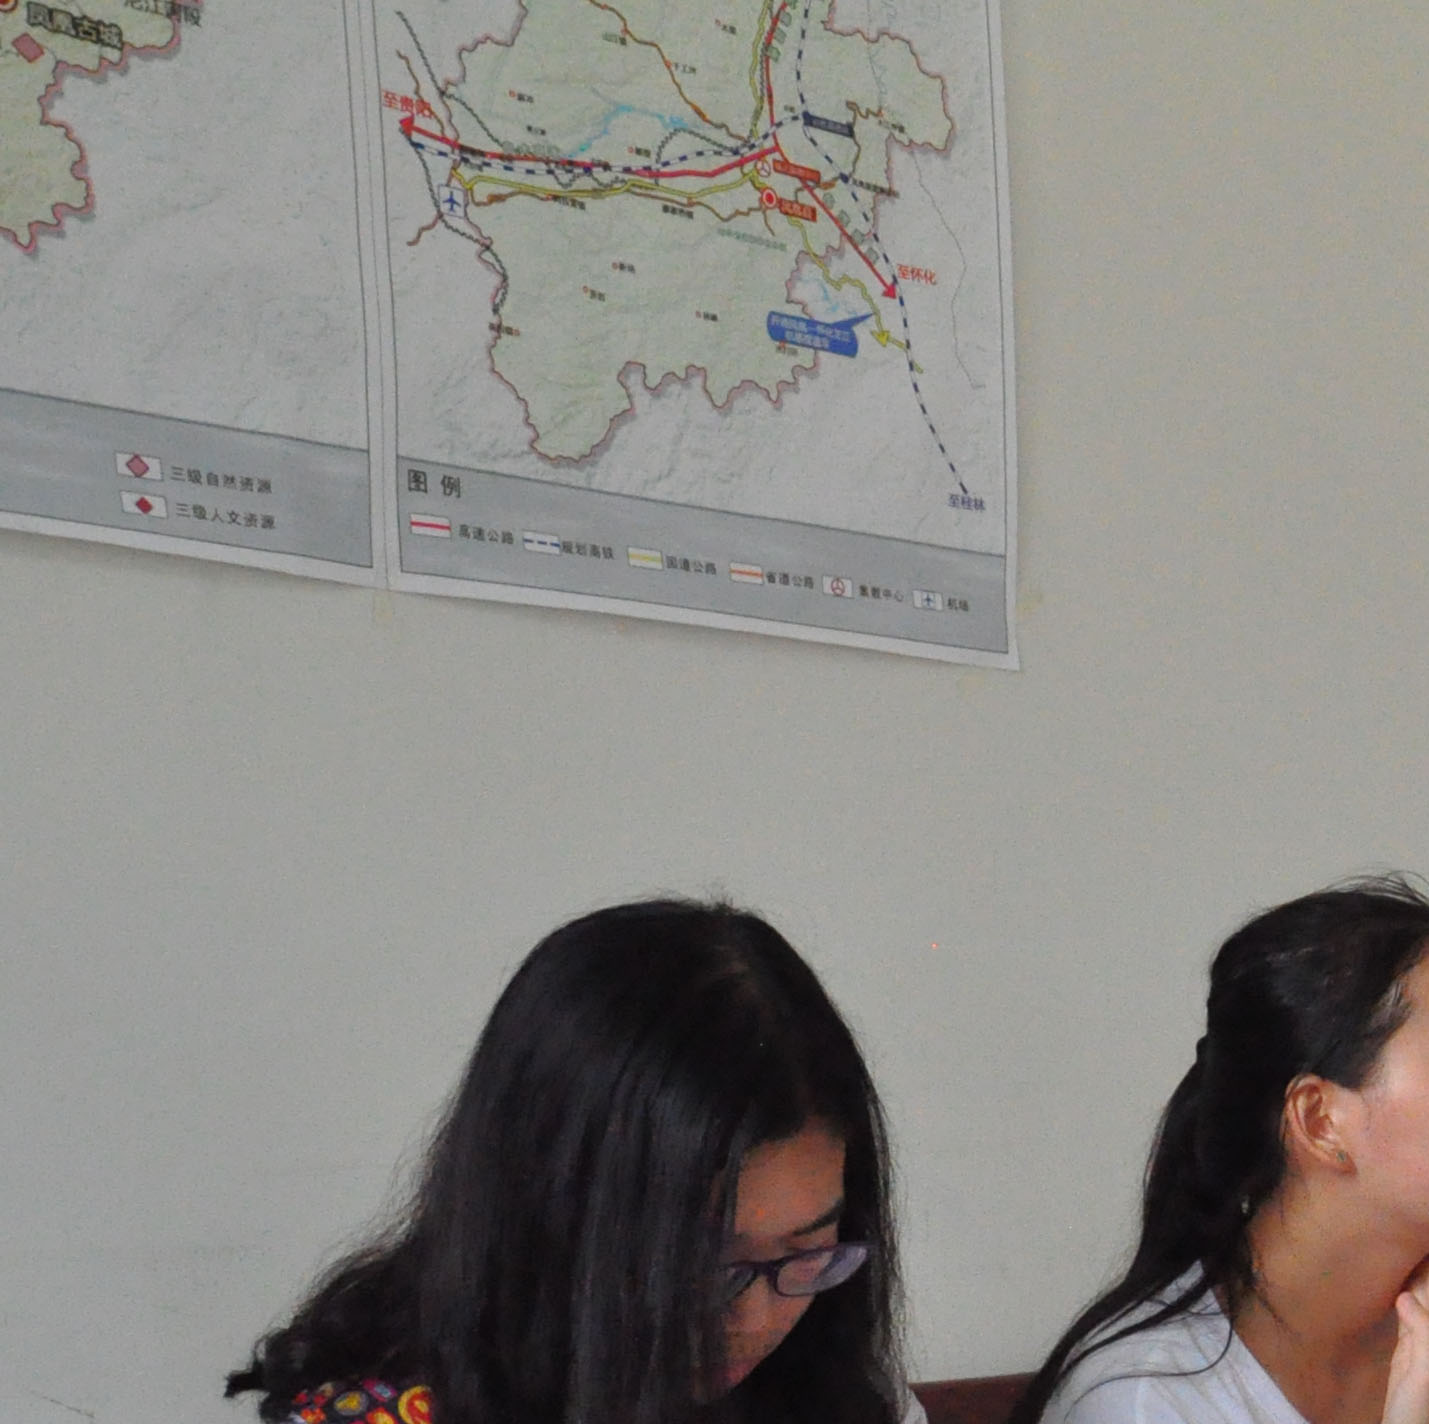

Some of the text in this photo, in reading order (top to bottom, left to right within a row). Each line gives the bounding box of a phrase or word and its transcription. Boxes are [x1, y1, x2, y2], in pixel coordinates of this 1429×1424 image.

[898, 264, 937, 285] 至怀化
[170, 466, 272, 493] 三级自然资源
[949, 494, 985, 511] 至桂林
[176, 502, 275, 529] 三级人文资源
[459, 524, 514, 545] 高速公路
[666, 556, 717, 575] 国道公路
[766, 572, 814, 589] 省道公路
